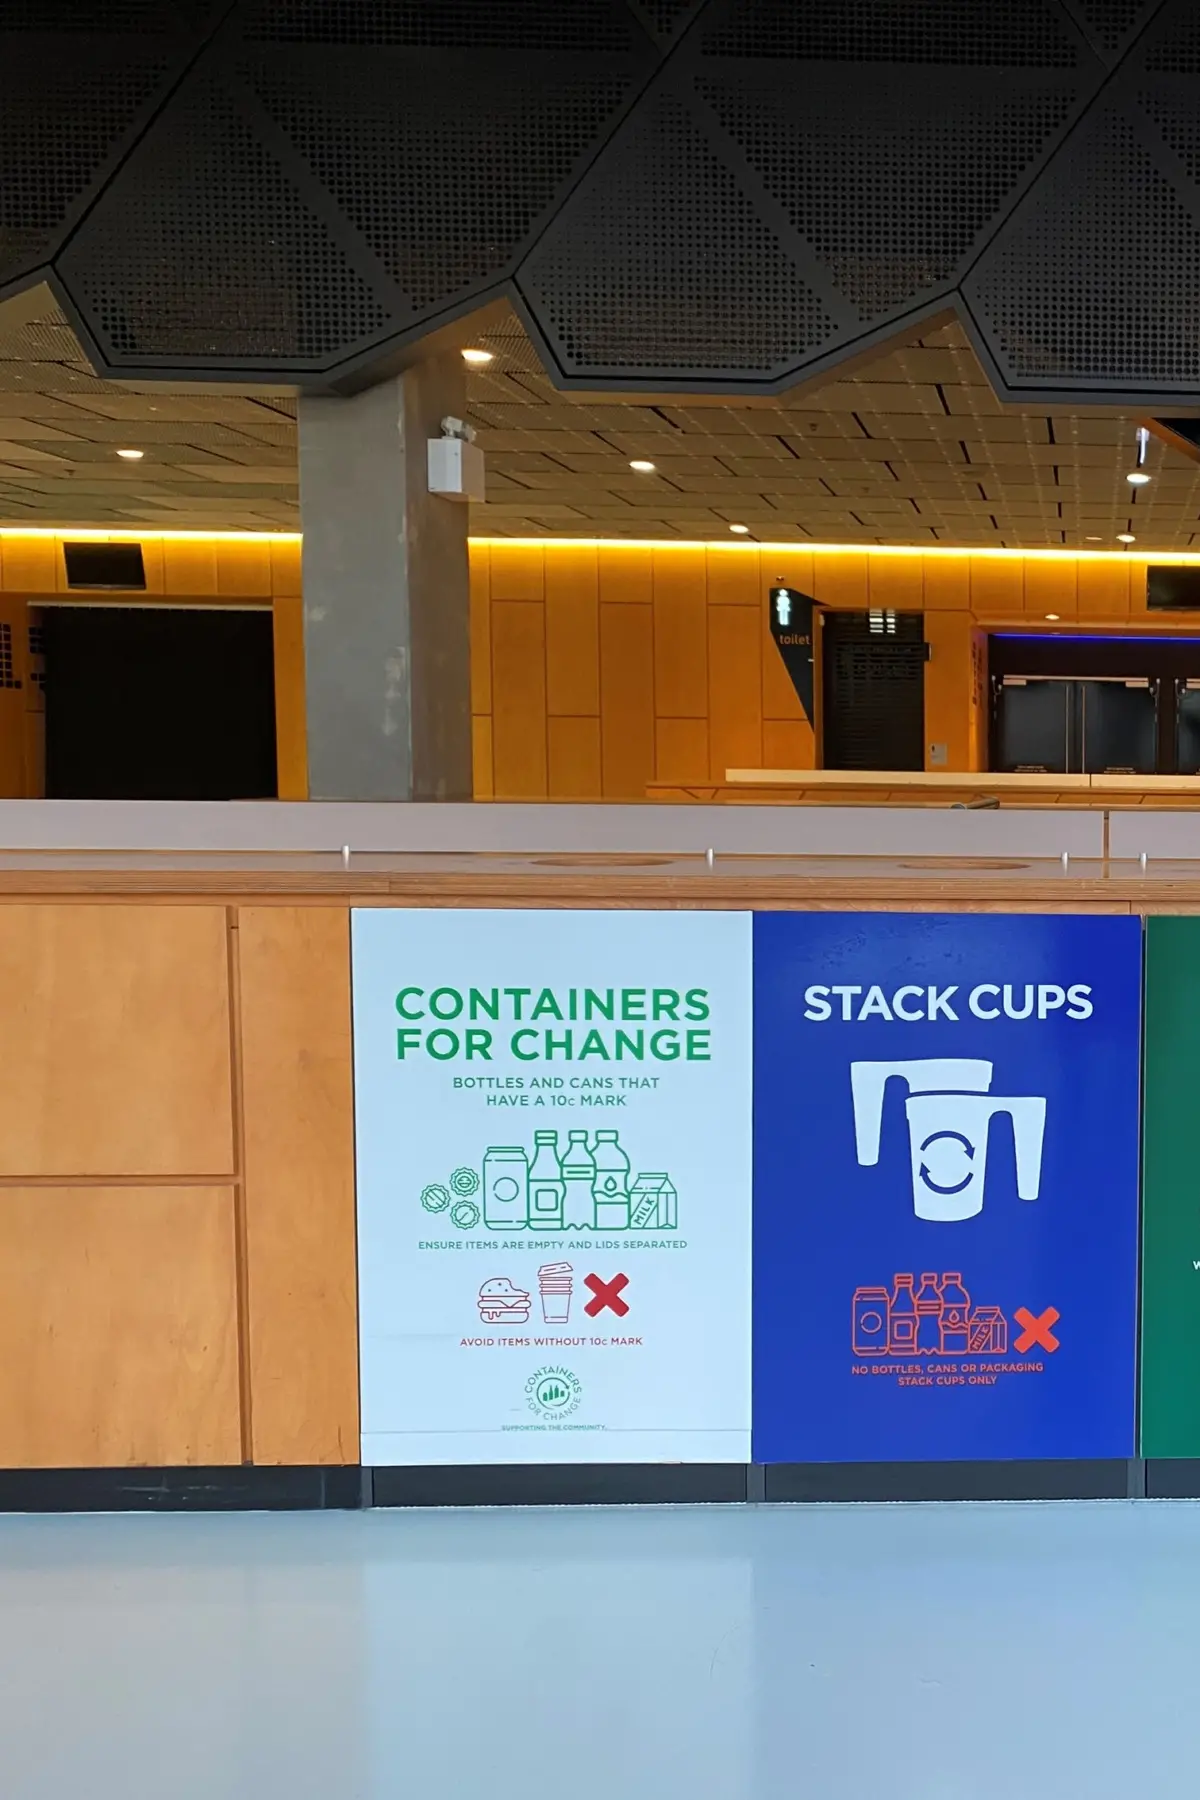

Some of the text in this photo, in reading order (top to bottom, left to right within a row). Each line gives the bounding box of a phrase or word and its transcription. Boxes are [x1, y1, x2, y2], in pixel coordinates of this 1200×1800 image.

[779, 634, 811, 645] toilet
[395, 987, 711, 1021] CONTAINERS
[803, 984, 1094, 1021] STACK CUPS
[397, 1028, 711, 1061] FOR CHANGE
[453, 1077, 660, 1089] BOTTLES AND CANS THAT
[486, 1095, 627, 1107] HAVE A 10c MARK
[633, 1196, 655, 1225] MILK
[418, 1240, 688, 1250] ENSURE ITEMS ARE EMPTY AND LIDS SEPARATED
[460, 1336, 643, 1347] AVOID ITEMS WITHOUT 10c MARK
[852, 1362, 1044, 1375] NO BOTTLES, CANS OR PACKAGING
[524, 1365, 582, 1394] CONTAINERS
[898, 1375, 997, 1386] STACK CUPS ONLY
[526, 1396, 581, 1420] FOR CHANGE
